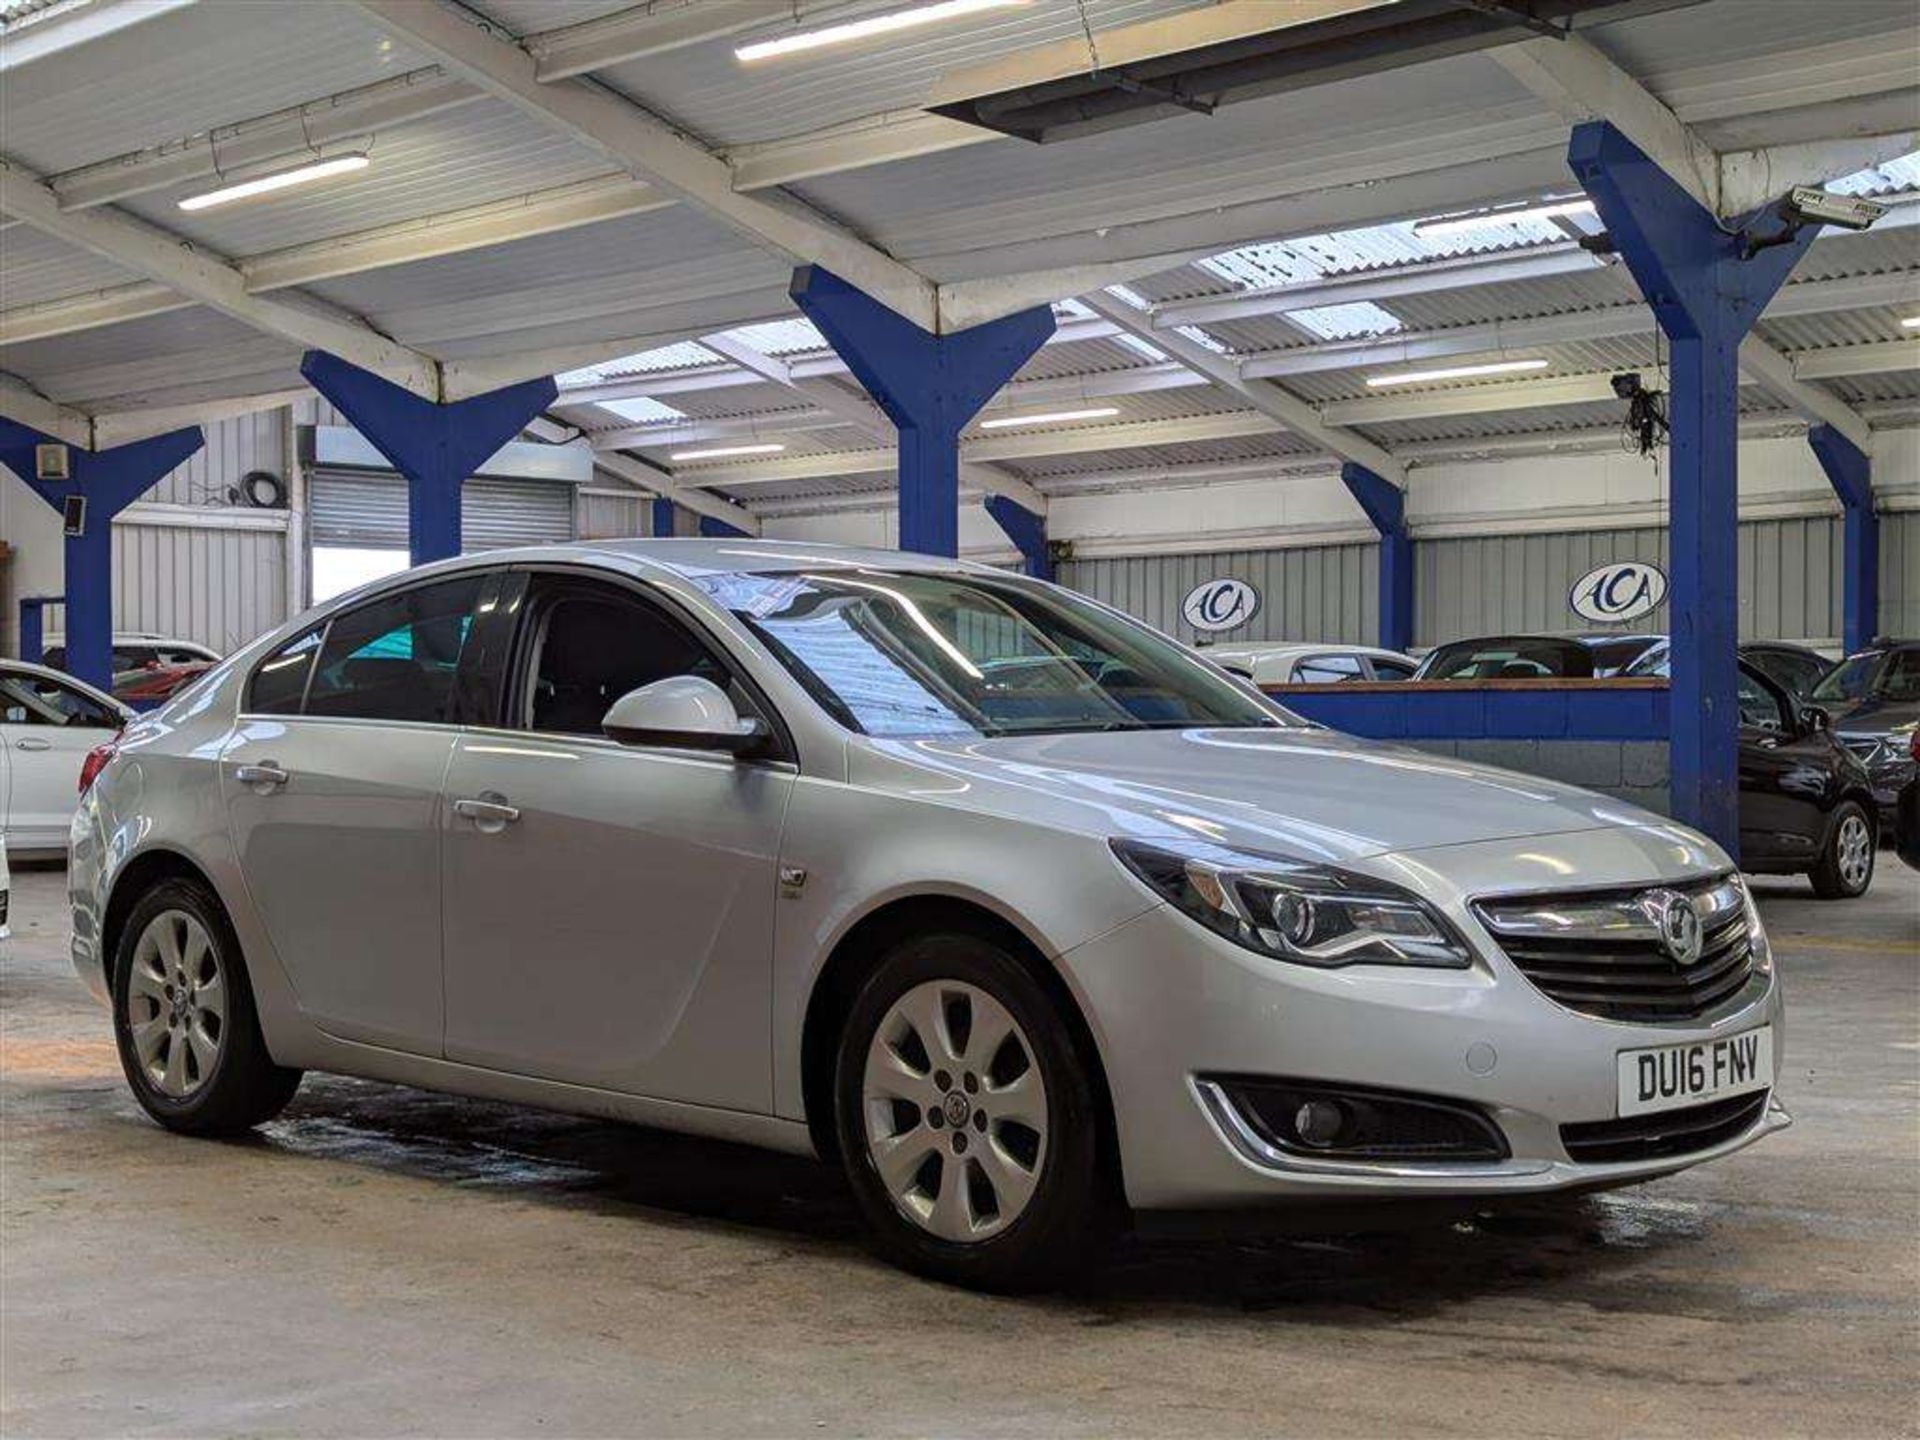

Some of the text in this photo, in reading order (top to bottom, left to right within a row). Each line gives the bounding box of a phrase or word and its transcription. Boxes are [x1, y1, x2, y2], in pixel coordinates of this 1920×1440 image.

[1187, 584, 1246, 623] ACA
[1576, 568, 1652, 613] ACA
[1638, 1035, 1758, 1101] DU16 FNV
